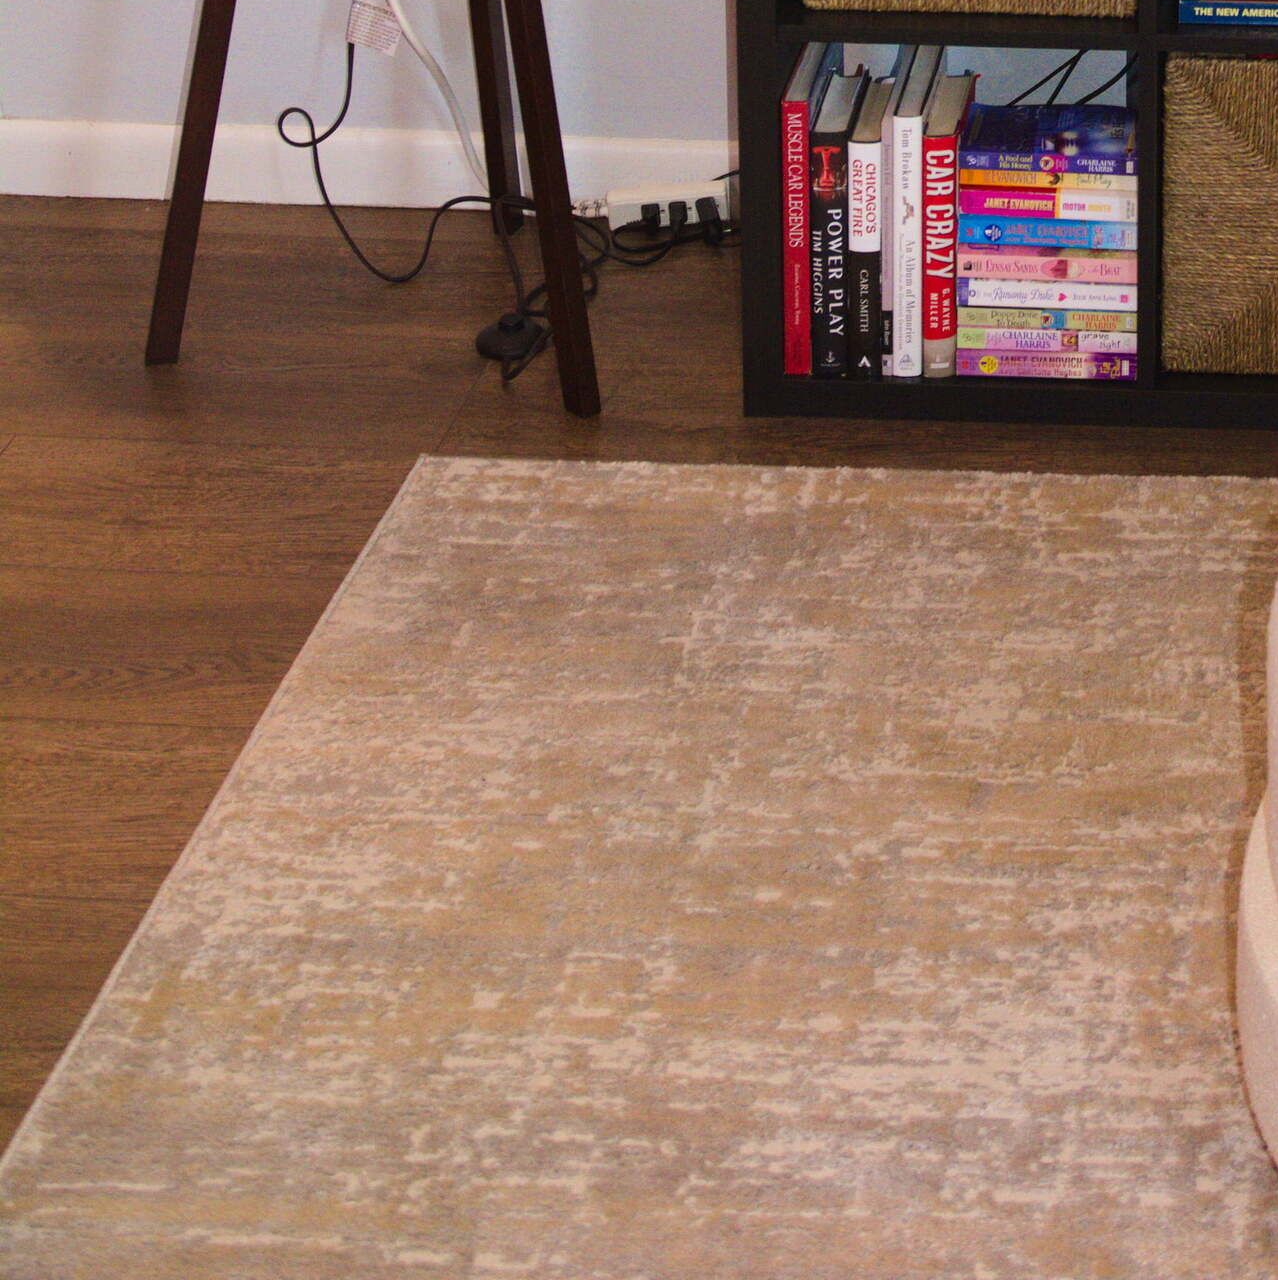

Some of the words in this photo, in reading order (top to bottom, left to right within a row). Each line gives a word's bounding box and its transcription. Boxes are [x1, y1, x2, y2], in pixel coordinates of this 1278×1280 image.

[1193, 7, 1213, 16] THE
[1216, 7, 1240, 17] NEW
[787, 113, 804, 162] MUSCLE
[901, 128, 913, 148] Tom
[787, 164, 804, 190] CAR
[902, 152, 913, 190] Brokaw
[925, 149, 955, 197] CAR
[1076, 158, 1117, 166] CHARLAINE
[1088, 165, 1114, 173] HARRIS
[852, 159, 863, 201] GREAT
[865, 162, 877, 234] CHICAGO'S
[984, 197, 1010, 210] JANET
[1010, 199, 1055, 212] EVANOVICH
[788, 193, 804, 248] LEGENDS
[852, 207, 863, 237] FIRE
[812, 229, 823, 252] TIM
[827, 208, 843, 280] POWER
[905, 240, 916, 253] An
[925, 204, 955, 279] CRAZY
[812, 257, 824, 314] HIGGINS
[860, 269, 870, 297] CARL
[905, 258, 916, 289] Album
[906, 290, 916, 299] of
[828, 289, 844, 336] PLAY
[860, 298, 870, 333] SMITH
[905, 299, 916, 344] Memories
[929, 292, 939, 329] MILLER
[942, 298, 951, 332] WAYNE
[1018, 311, 1039, 319] Done
[1072, 313, 1120, 322] CHARLAINE
[1085, 321, 1117, 329] HARRIS
[1002, 330, 1059, 341] CHARLAINE
[1015, 340, 1052, 349] HARRIS
